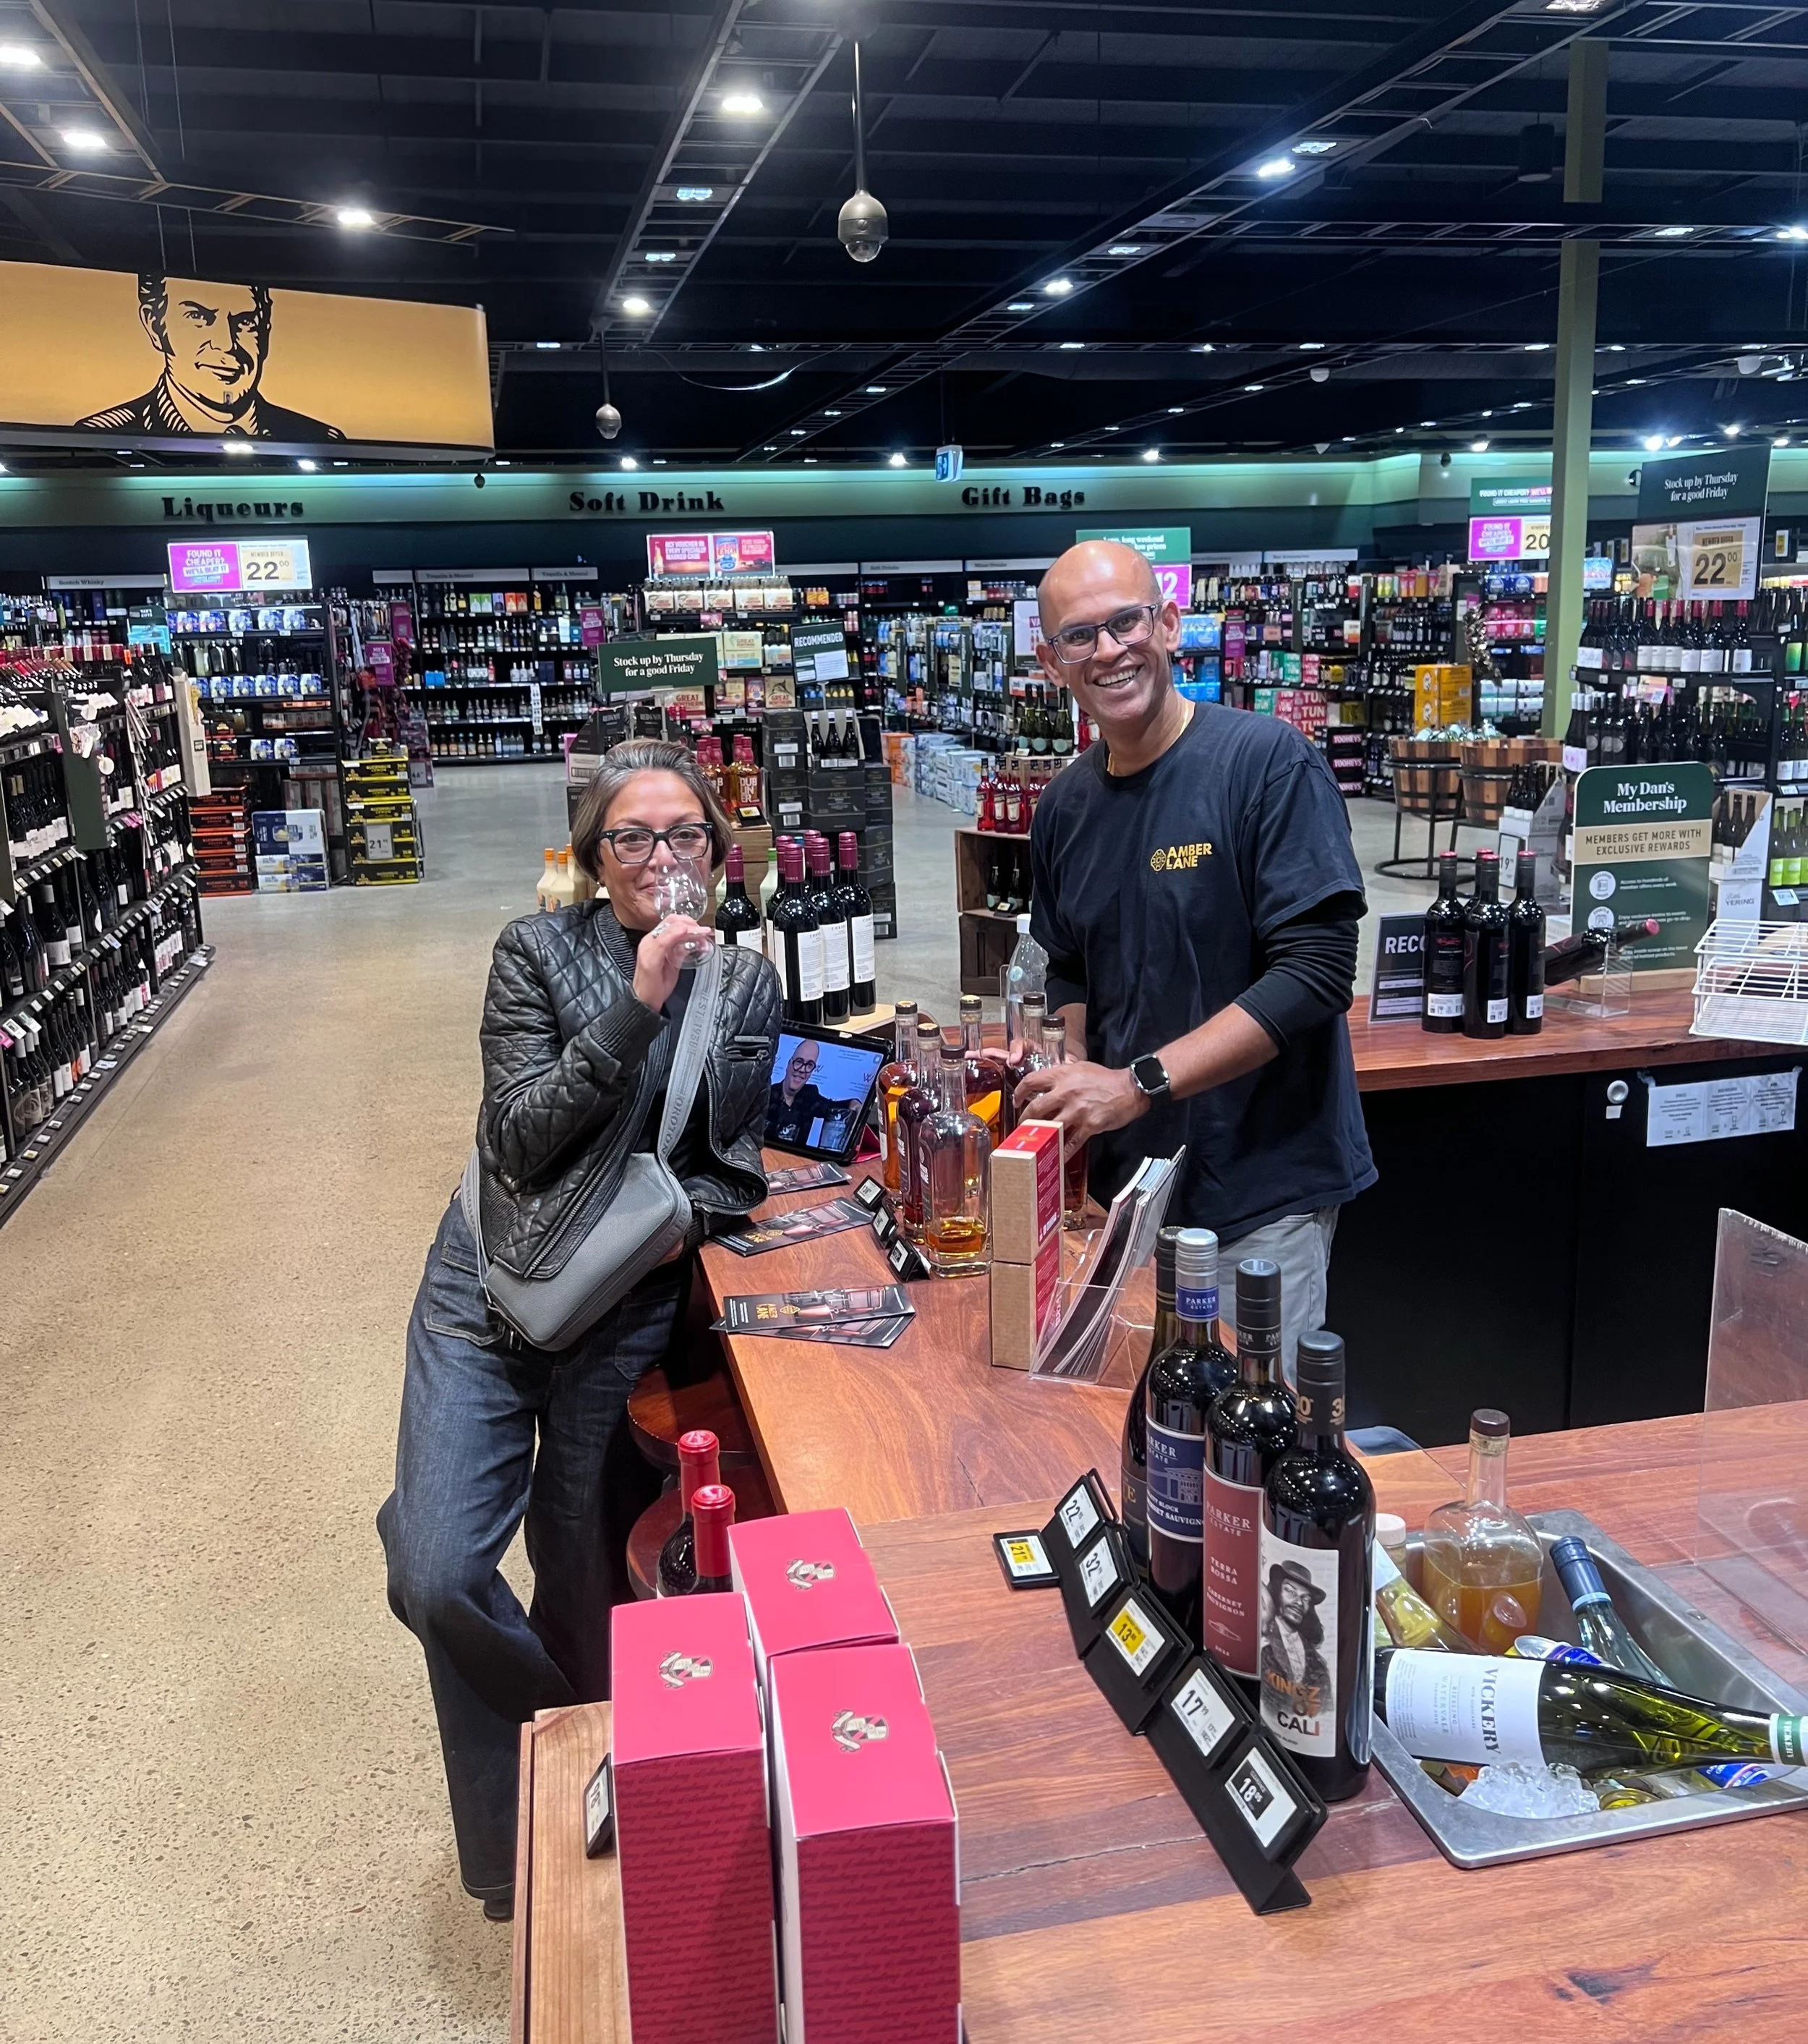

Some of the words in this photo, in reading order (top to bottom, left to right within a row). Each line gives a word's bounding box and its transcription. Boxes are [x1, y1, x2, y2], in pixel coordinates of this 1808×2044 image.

[1665, 477, 1683, 490] Stock
[1684, 479, 1694, 490] up
[1694, 476, 1702, 489] by
[1705, 472, 1739, 486] Thursday
[568, 491, 626, 511] Soft
[638, 490, 725, 512] Drink
[961, 486, 1011, 506] Gift
[1023, 487, 1086, 509] Bags
[1671, 491, 1681, 502] for
[1687, 487, 1705, 503] good
[1705, 486, 1729, 500] Friday
[161, 497, 304, 522] Liqueurs
[1525, 534, 1549, 550] 20
[186, 558, 225, 566] CHEAPER?
[187, 549, 212, 558] FOUND
[213, 549, 221, 558] IT
[246, 561, 280, 581] 22
[1694, 552, 1727, 585] 22
[1727, 552, 1738, 562] 00
[794, 631, 843, 648] RECOMMENDED
[614, 656, 639, 667] Stock
[639, 657, 651, 668] up
[652, 654, 663, 666] by
[664, 652, 704, 665] Thursday
[625, 666, 639, 677] for
[646, 666, 668, 678] good
[668, 663, 696, 676] Friday
[1303, 691, 1327, 704] TUN
[1302, 706, 1326, 717] TUN
[1333, 733, 1363, 744] TOOHEYS
[1334, 758, 1363, 767] TOOHEYS
[739, 777, 757, 786] DUB
[1617, 783, 1637, 800] My
[1639, 781, 1675, 795] Dan's
[1603, 796, 1687, 814] Membership
[369, 840, 382, 849] 21
[1585, 833, 1629, 845] MEMBERS
[1632, 832, 1648, 841] GET
[1651, 830, 1676, 840] MORE
[1679, 828, 1702, 838] WITH
[1167, 843, 1213, 859] AMBER
[1596, 844, 1645, 855] EXCLUSIVE
[1648, 840, 1690, 851] REWARDS
[1166, 855, 1198, 870] LANE
[1186, 1296, 1216, 1305] PARKER
[1239, 1332, 1253, 1342] KER
[1266, 1332, 1282, 1340] PAR
[1147, 1434, 1177, 1457] RKER
[1065, 1499, 1080, 1523] 22
[1159, 1500, 1180, 1513] BLOCK
[1165, 1510, 1203, 1525] SAUVIGN
[1206, 1501, 1251, 1530] PARKER
[1010, 1545, 1026, 1557] 21
[1086, 1552, 1101, 1577] 32
[1210, 1556, 1238, 1576] TERRA
[1210, 1564, 1238, 1585] ROSSA
[1207, 1585, 1242, 1609] CABERNET
[1117, 1623, 1133, 1643] 13
[1264, 1669, 1321, 1701] KINGZ
[1182, 1690, 1203, 1716] 17
[1293, 1700, 1321, 1719] OF
[1439, 1674, 1449, 1734] WATERVALE
[1481, 1667, 1501, 1755] VICKERY
[1277, 1711, 1320, 1737] CALI
[1239, 1777, 1258, 1802] 18
